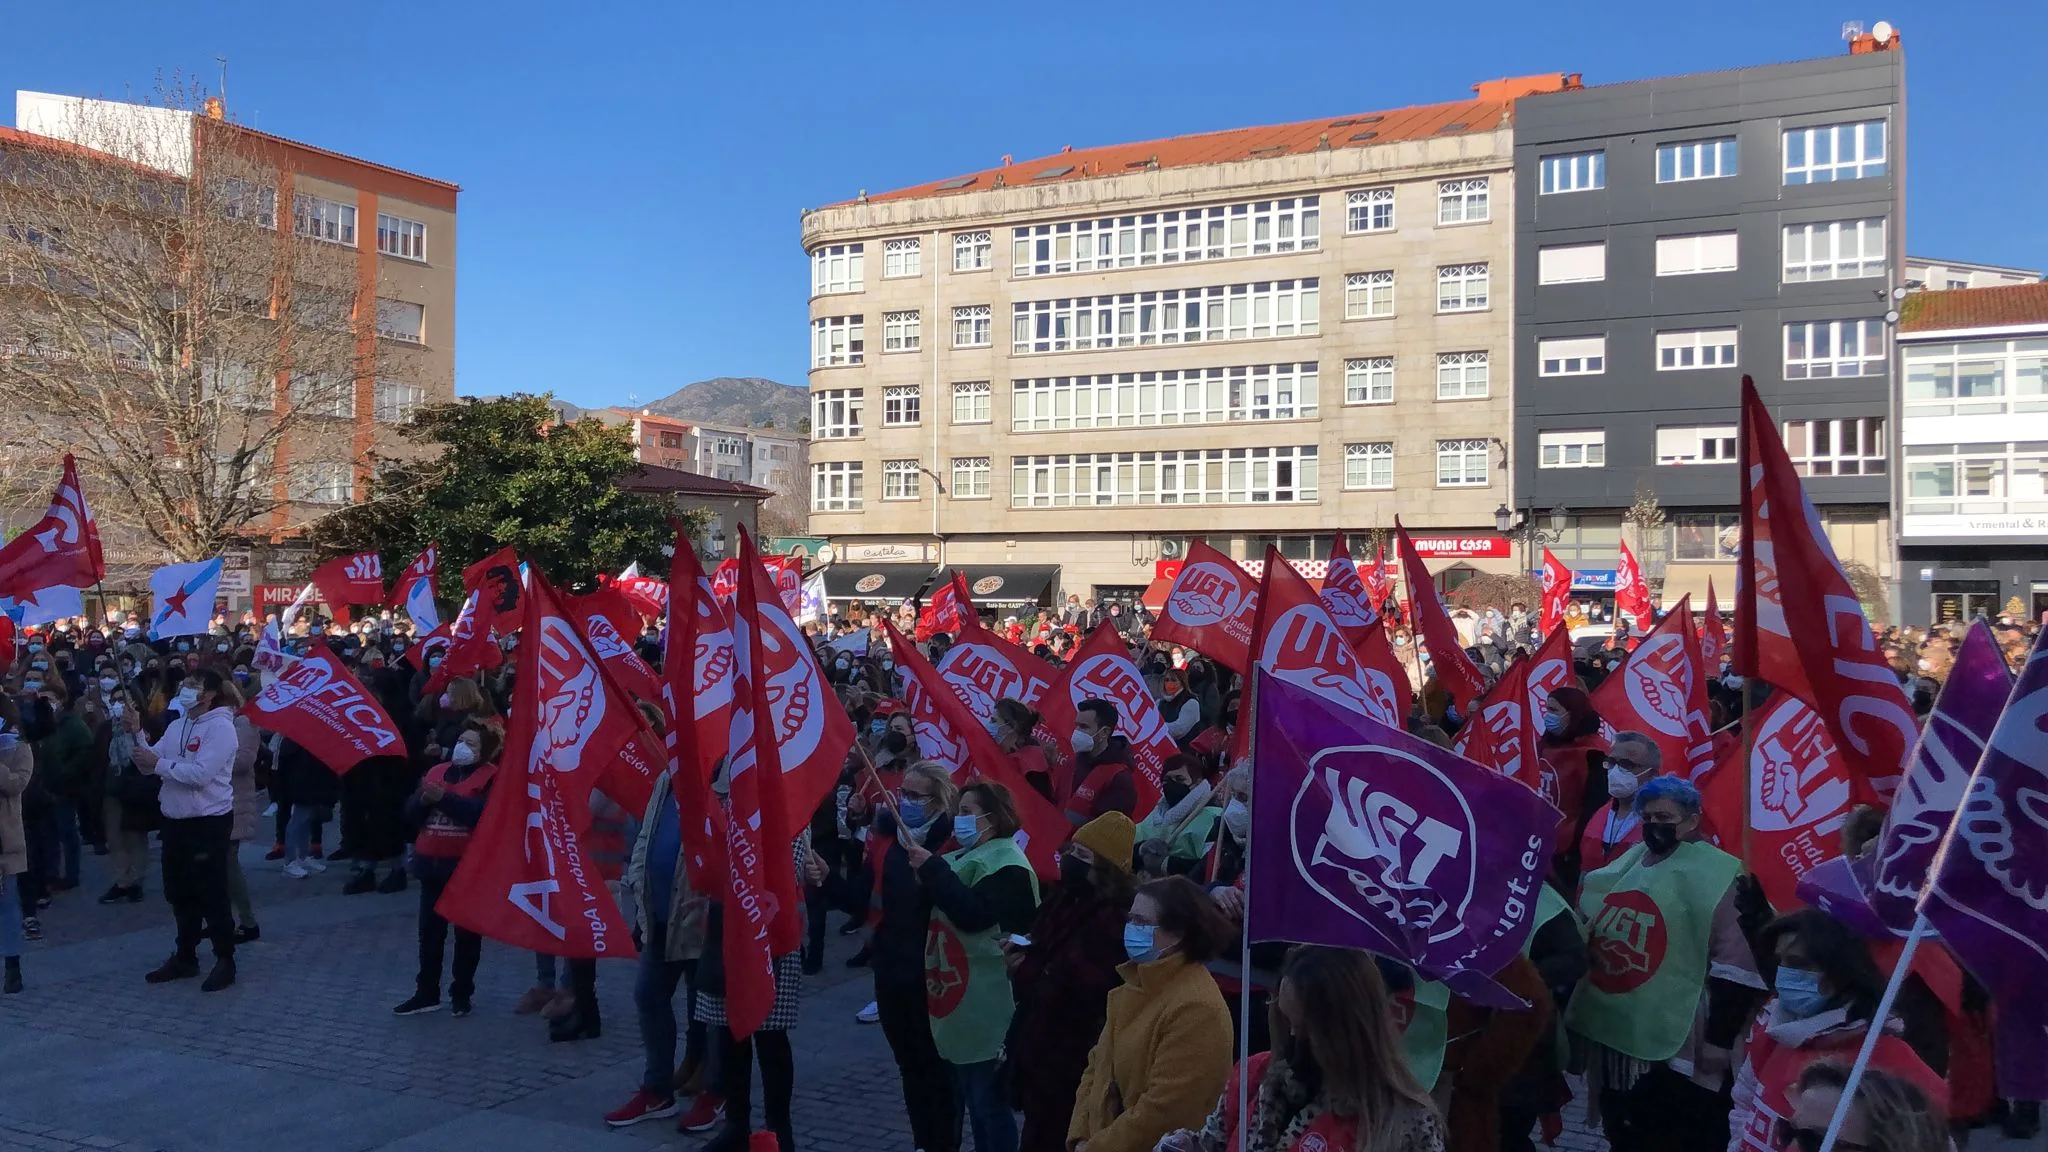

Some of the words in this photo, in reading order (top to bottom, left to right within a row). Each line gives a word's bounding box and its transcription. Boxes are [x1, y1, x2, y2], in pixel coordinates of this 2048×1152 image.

[1415, 539, 1458, 551] MUNDI
[1459, 539, 1492, 551] CASA
[1177, 566, 1237, 606] UGT
[948, 646, 1018, 702] UGT
[1084, 656, 1156, 725] UGT
[296, 700, 346, 735] Construcción
[1325, 766, 1463, 886] UGT
